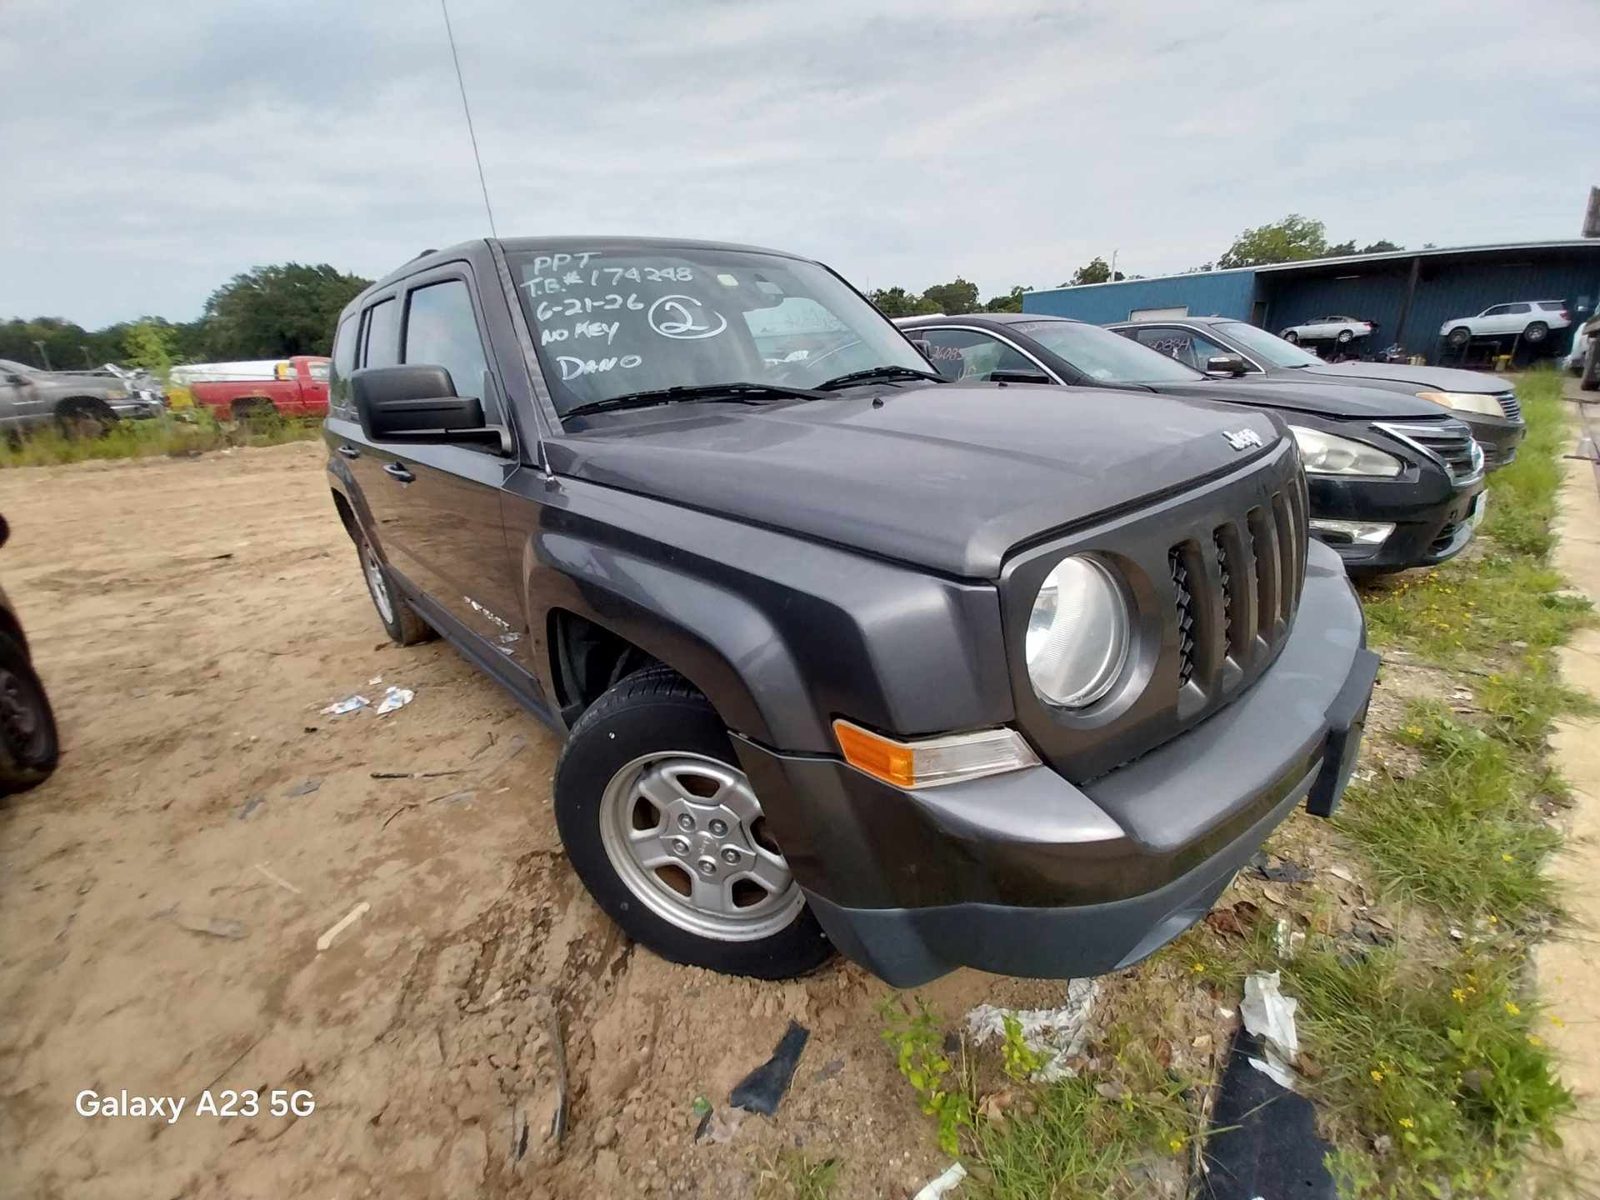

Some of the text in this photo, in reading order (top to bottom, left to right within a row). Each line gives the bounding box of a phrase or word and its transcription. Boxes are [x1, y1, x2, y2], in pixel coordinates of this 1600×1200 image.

[534, 252, 602, 276] PPT
[536, 293, 645, 321] 6-21-26
[541, 320, 620, 346] NO KEY
